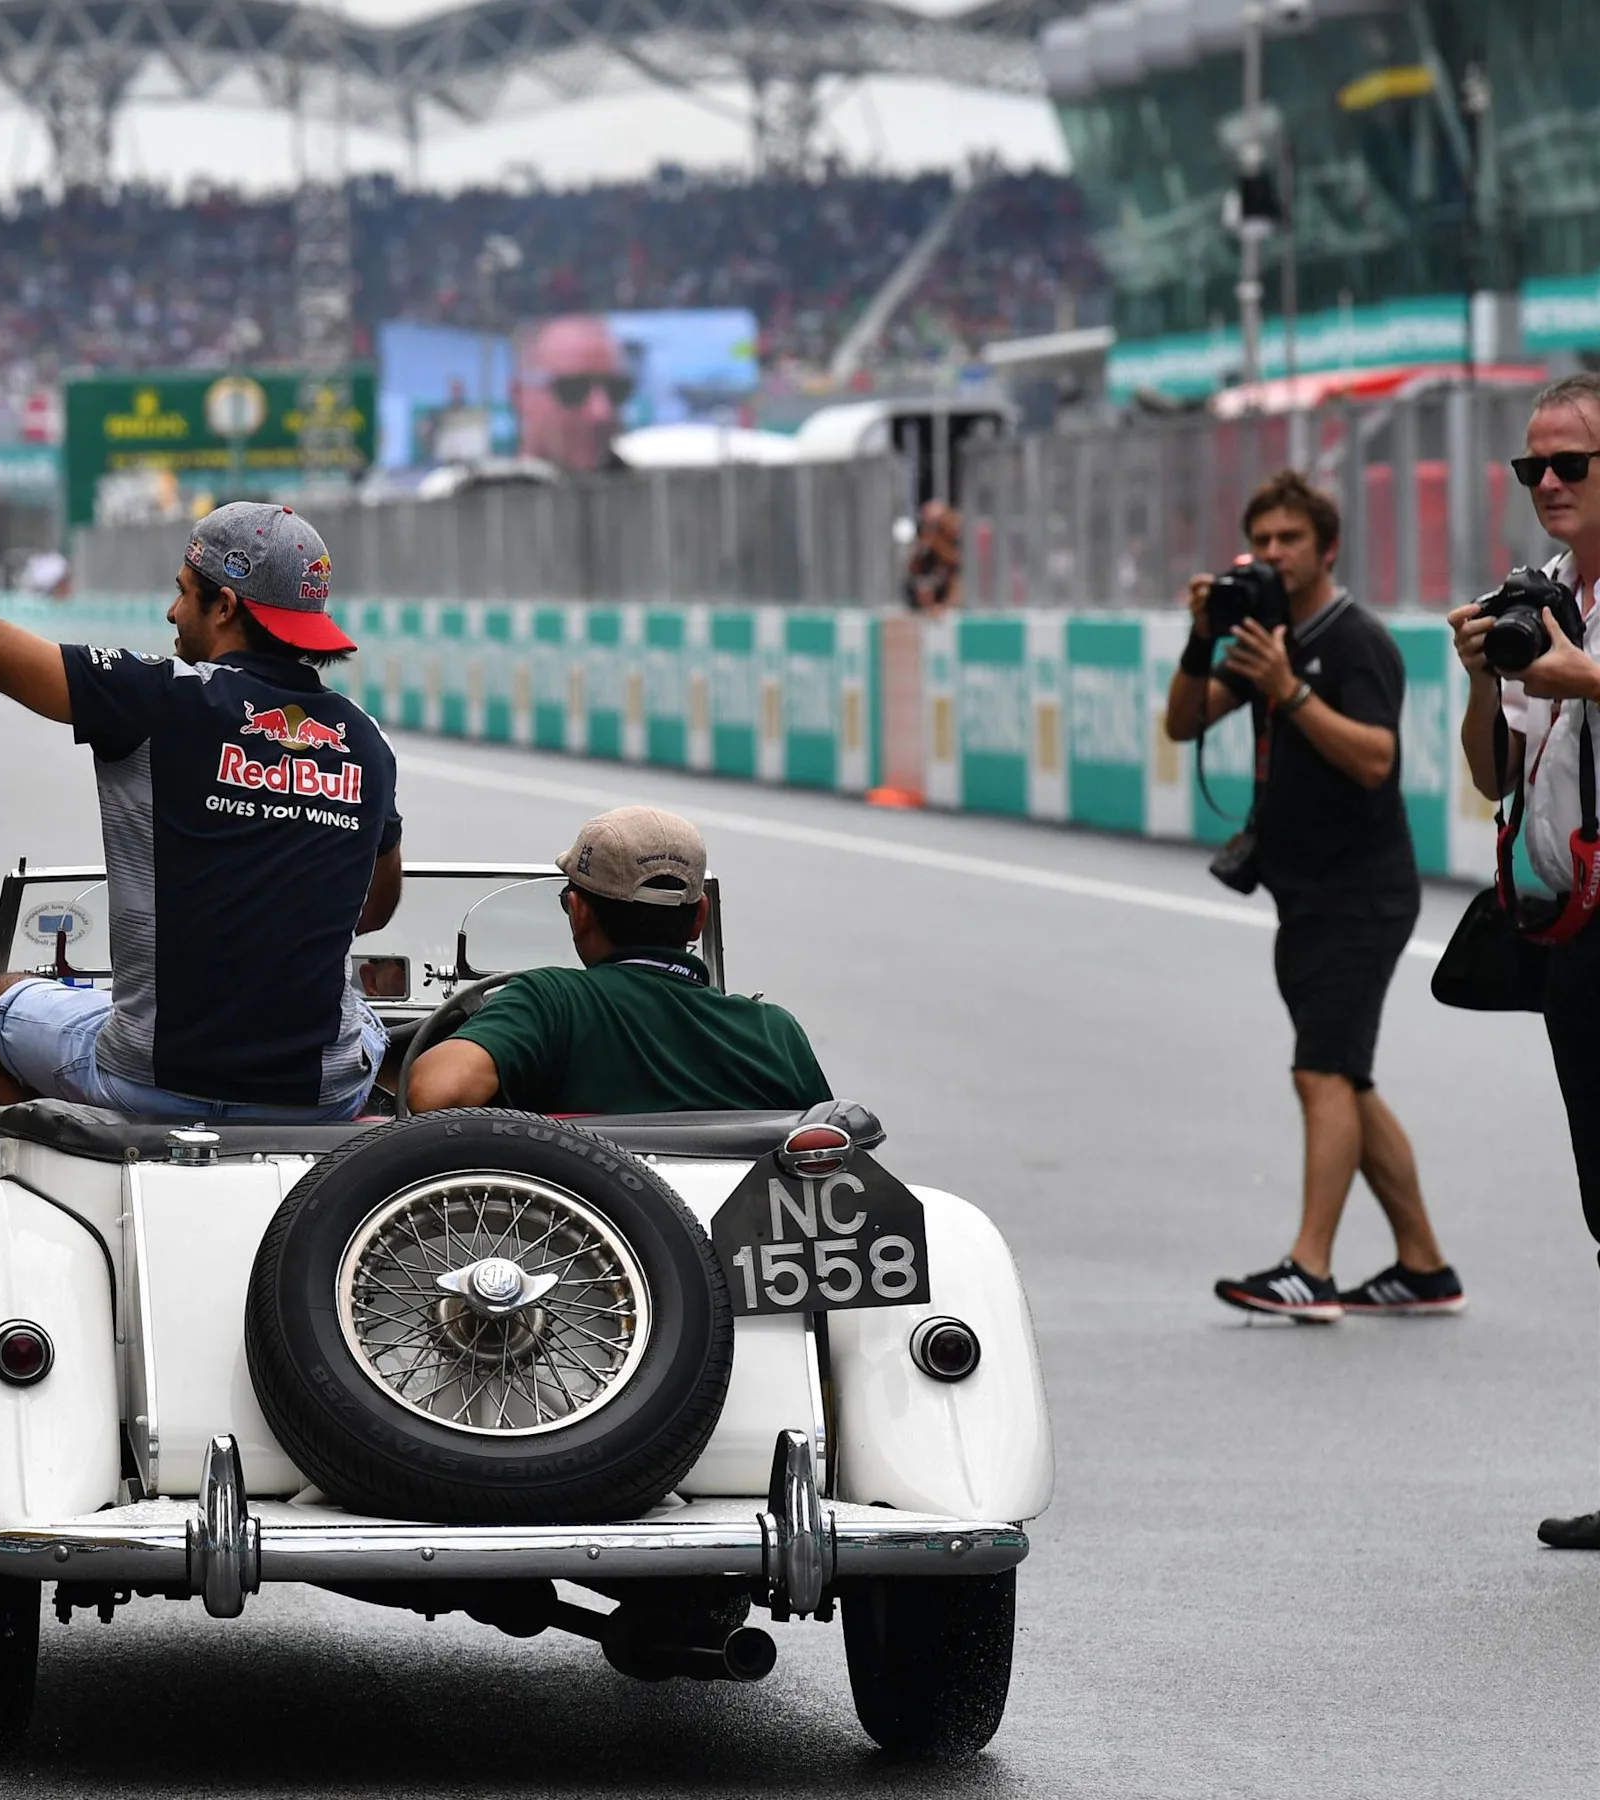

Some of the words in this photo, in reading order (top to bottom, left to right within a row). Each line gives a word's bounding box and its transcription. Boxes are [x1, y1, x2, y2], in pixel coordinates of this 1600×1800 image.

[216, 742, 291, 794] Red
[293, 758, 362, 804] Bull
[205, 795, 256, 817] GIVES
[261, 804, 302, 820] YOU
[305, 807, 360, 831] WINGS
[492, 1121, 645, 1191] KUMHO
[768, 1172, 868, 1241] NC
[732, 1234, 917, 1309] 1558
